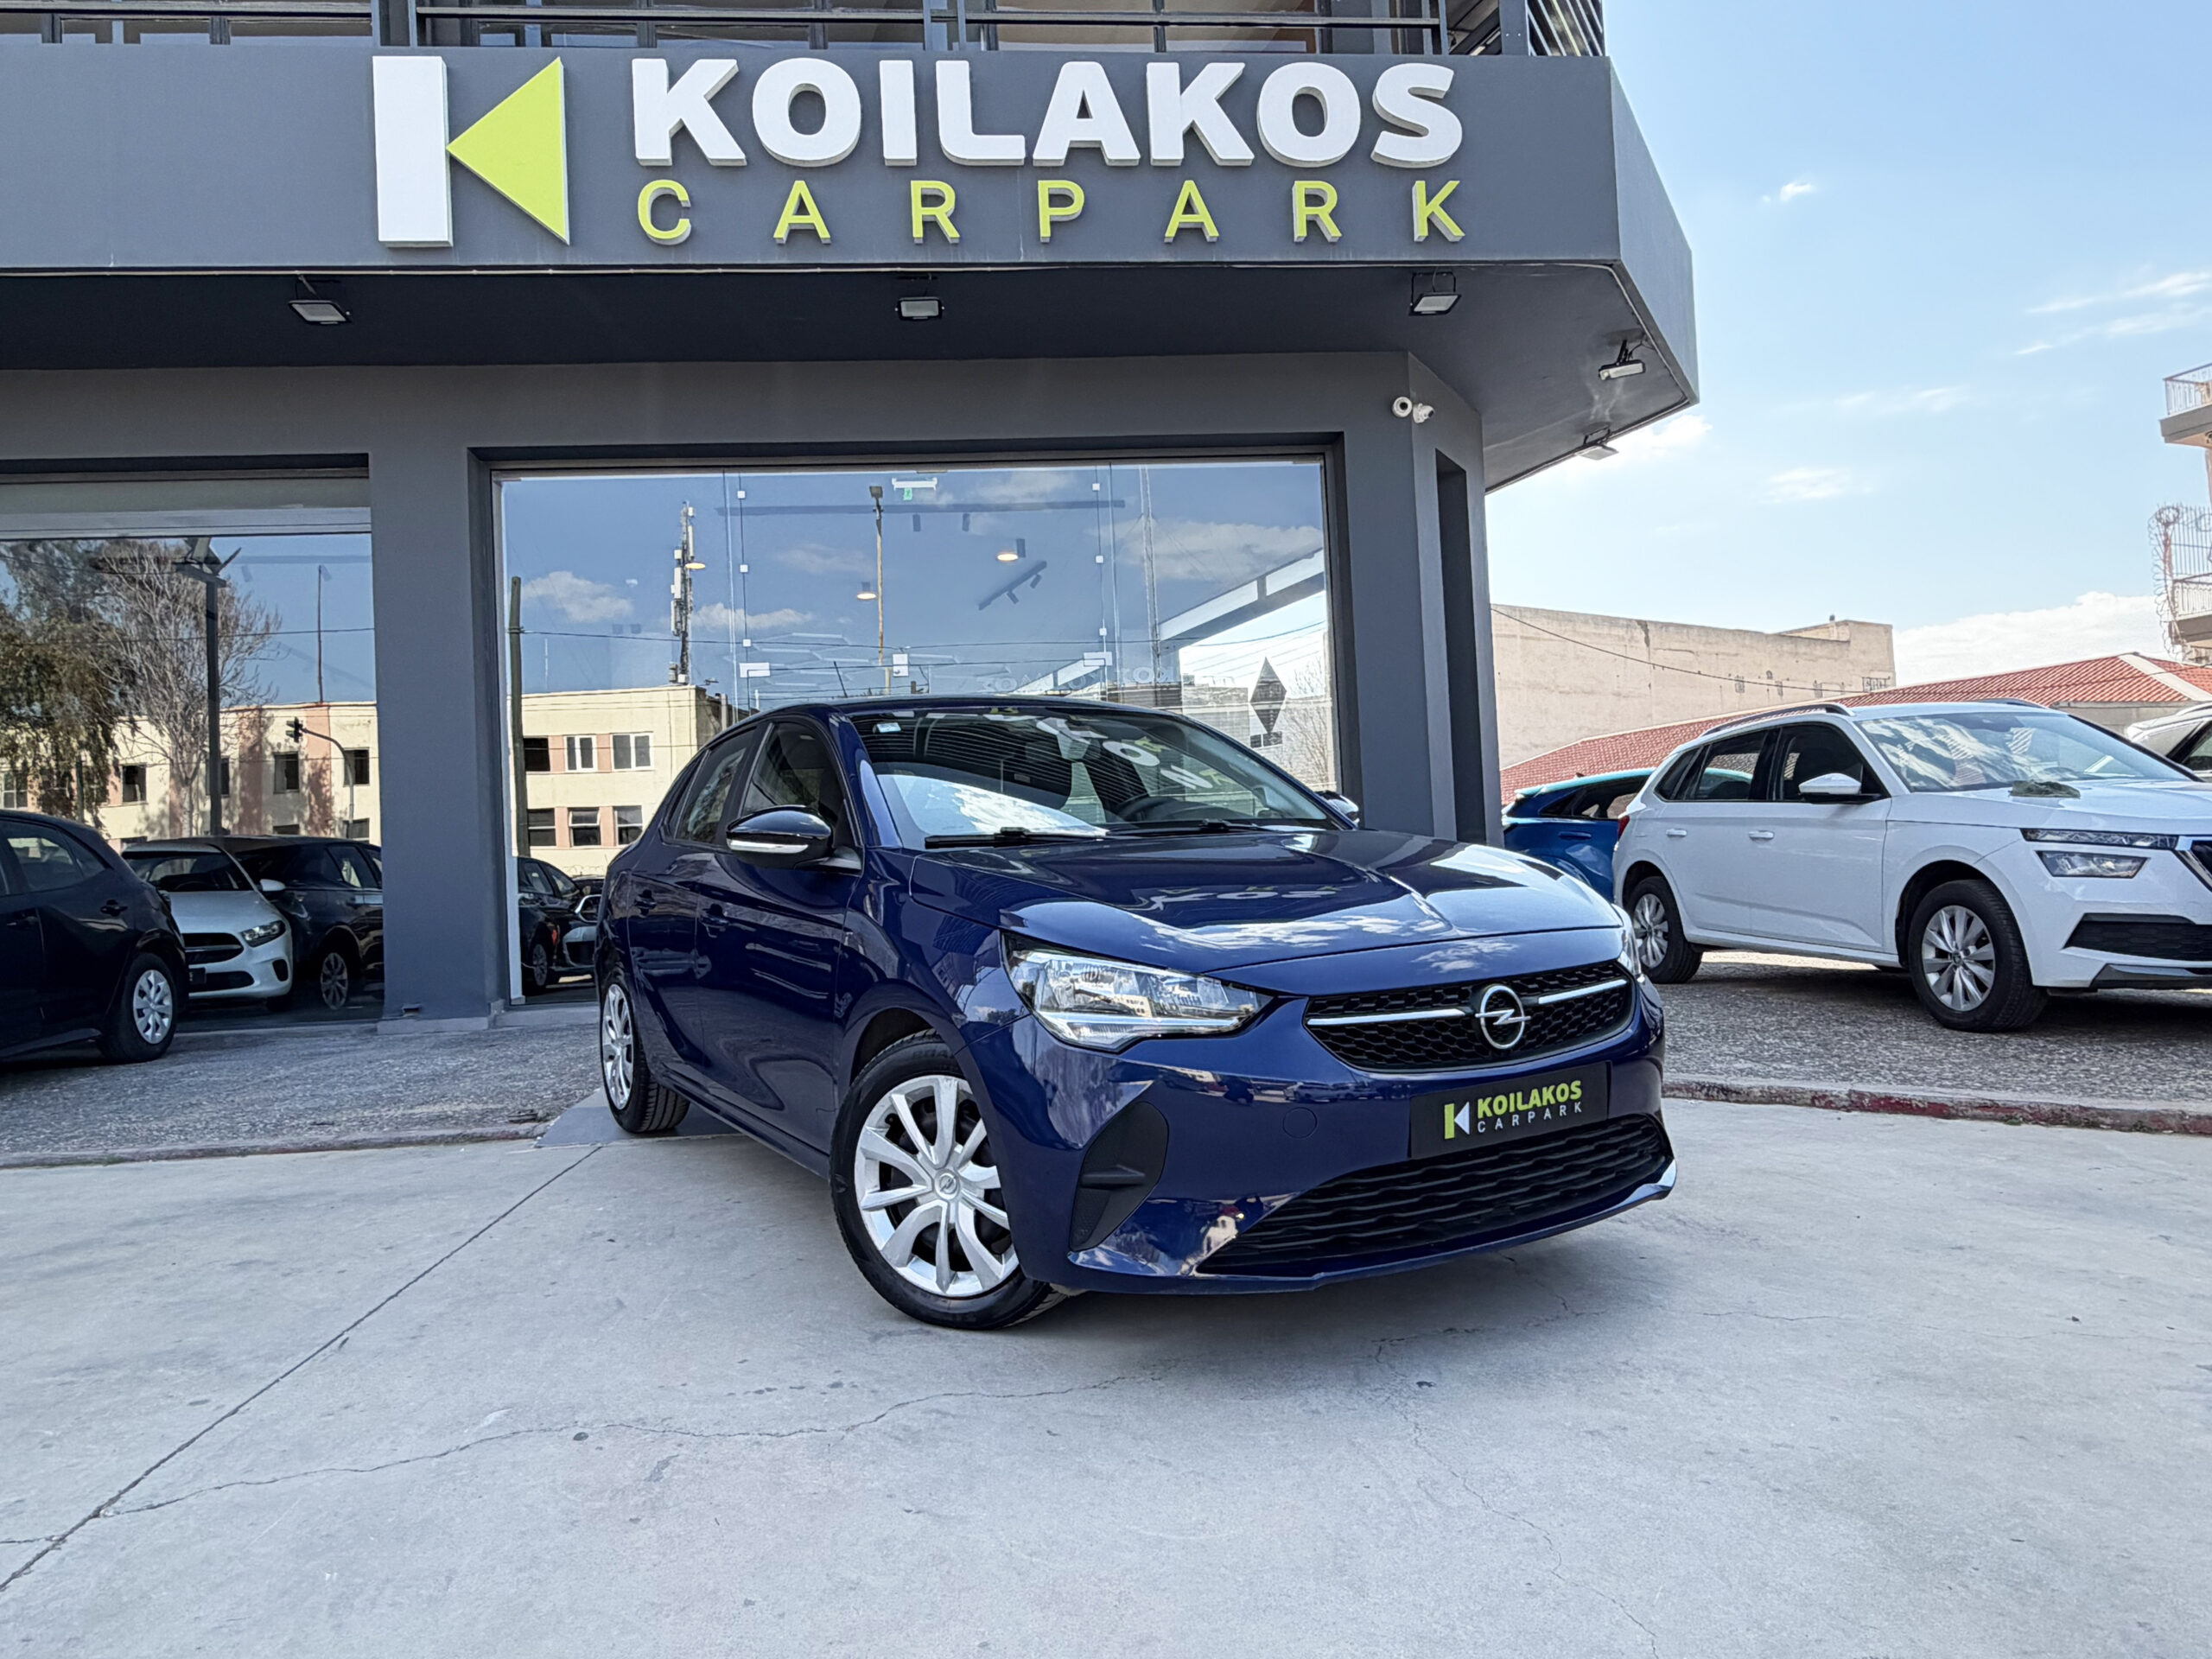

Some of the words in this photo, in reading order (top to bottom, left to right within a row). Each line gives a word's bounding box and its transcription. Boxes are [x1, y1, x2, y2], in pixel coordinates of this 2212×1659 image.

[632, 58, 1464, 168] KOILAKOS
[638, 179, 1465, 246] CARPARK
[1478, 1080, 1582, 1119] KOILAKOS
[1478, 1102, 1582, 1133] CARPARK
